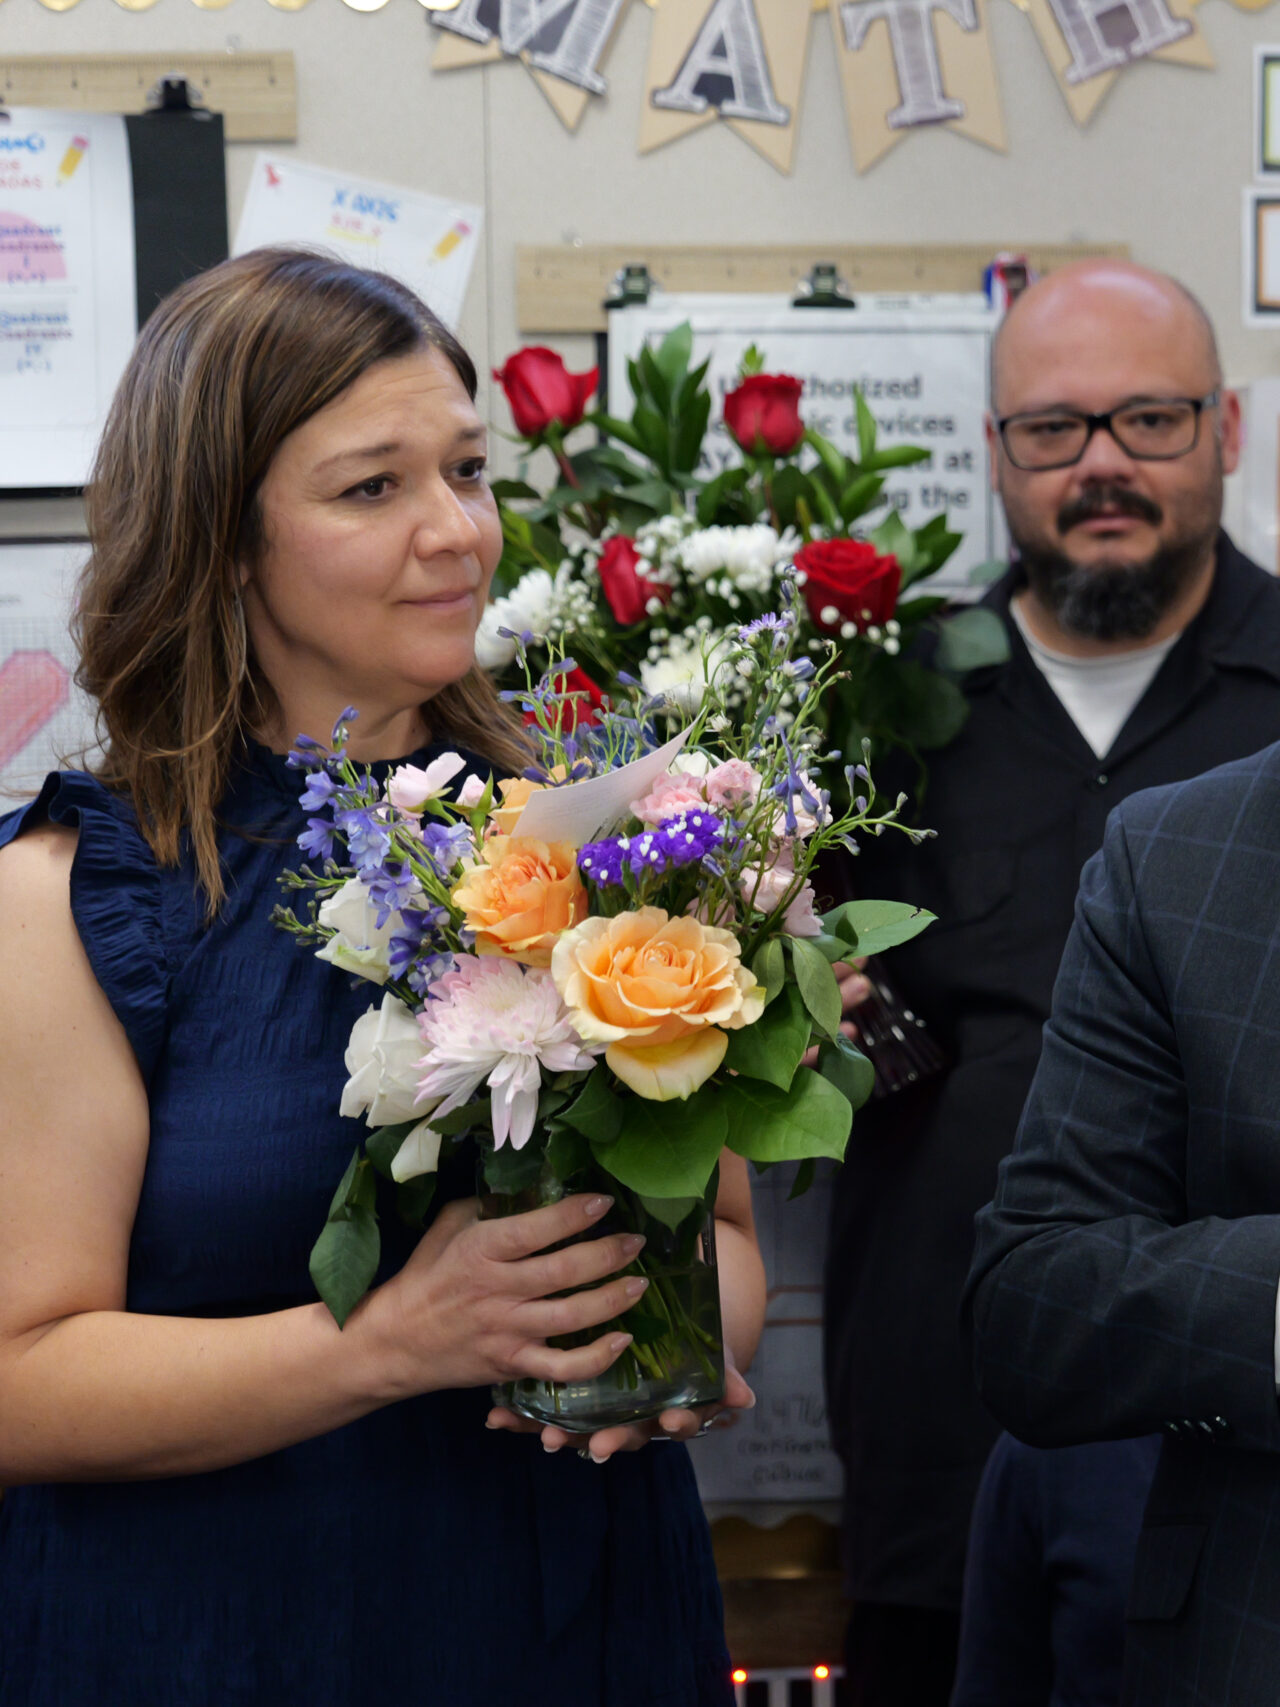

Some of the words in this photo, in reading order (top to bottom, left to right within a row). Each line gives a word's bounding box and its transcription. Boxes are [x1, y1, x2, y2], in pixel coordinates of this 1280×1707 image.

[428, 0, 1194, 132] MATH
[944, 453, 973, 471] at
[919, 486, 968, 507] the
